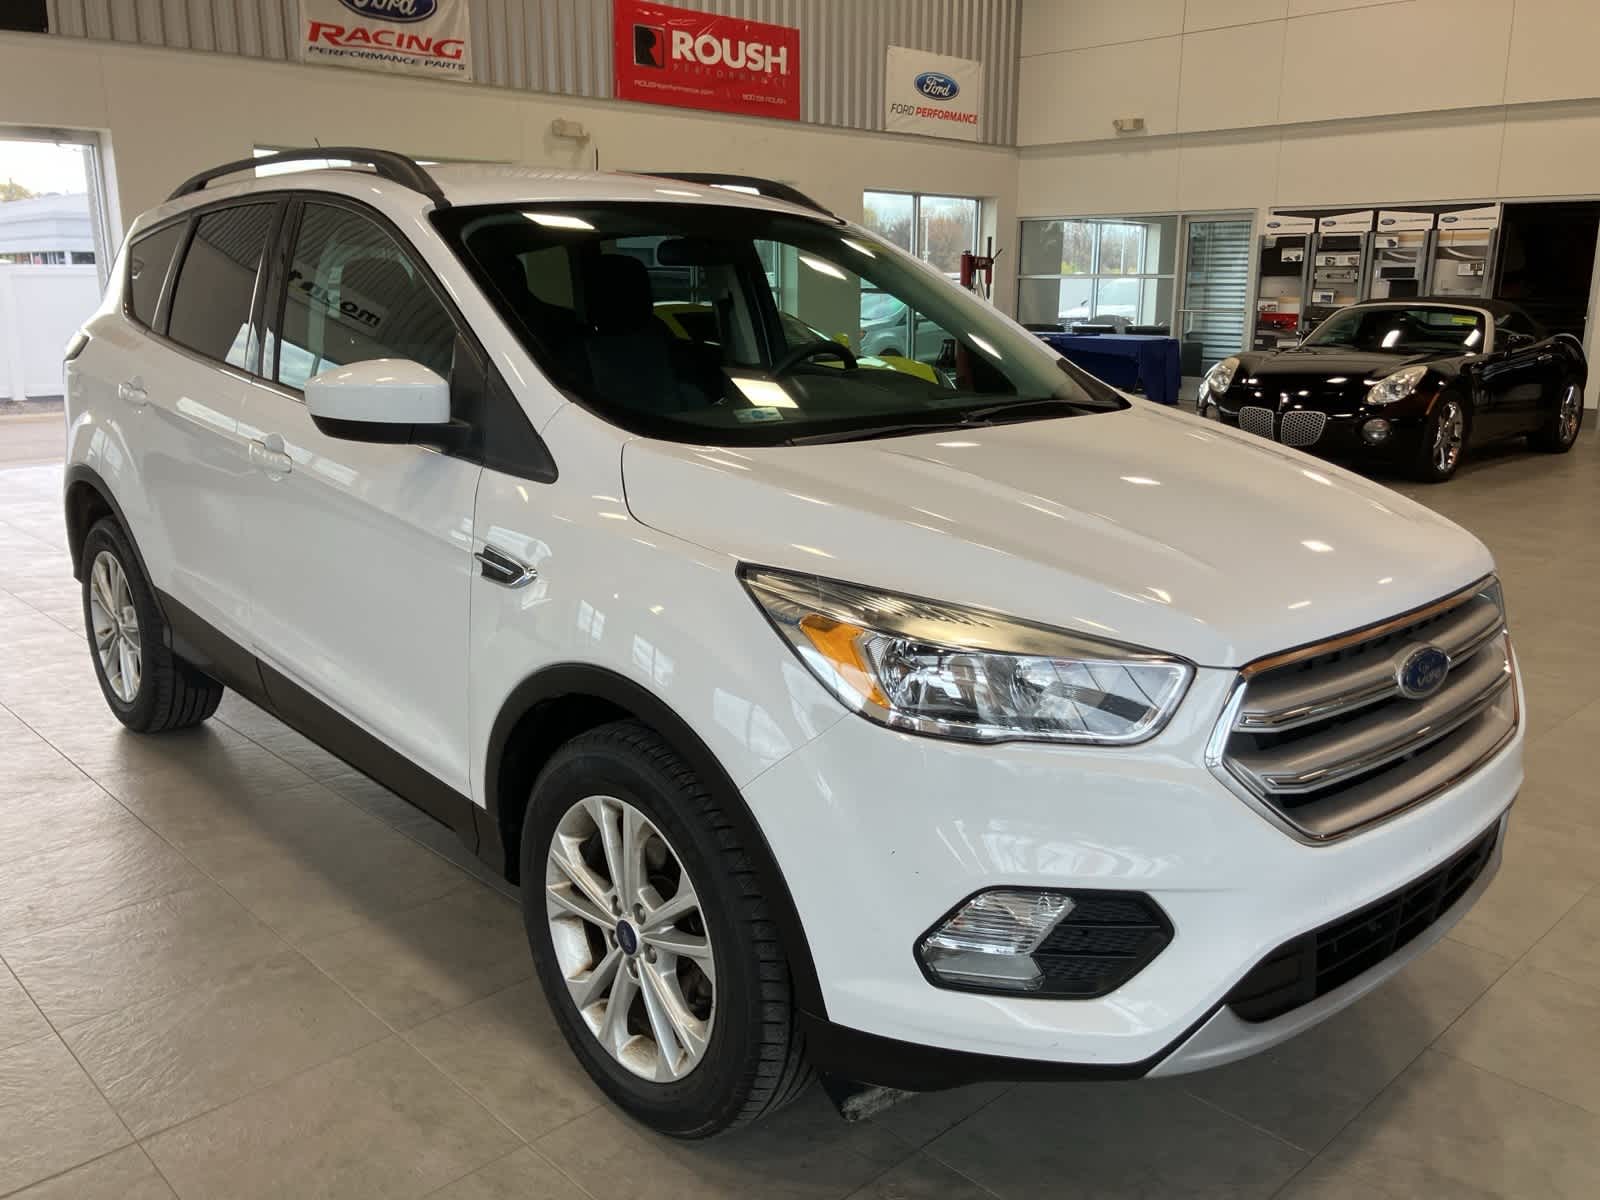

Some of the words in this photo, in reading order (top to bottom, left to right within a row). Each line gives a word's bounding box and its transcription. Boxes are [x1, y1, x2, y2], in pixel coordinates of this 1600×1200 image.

[353, 0, 416, 15] ord
[308, 21, 464, 59] RACING
[308, 45, 421, 65] PERFORMANCE
[424, 59, 465, 71] PARTS
[672, 30, 787, 74] ROUSH
[923, 76, 951, 97] Ford
[890, 103, 914, 116] FORD
[916, 107, 977, 124] PERFORMANCE
